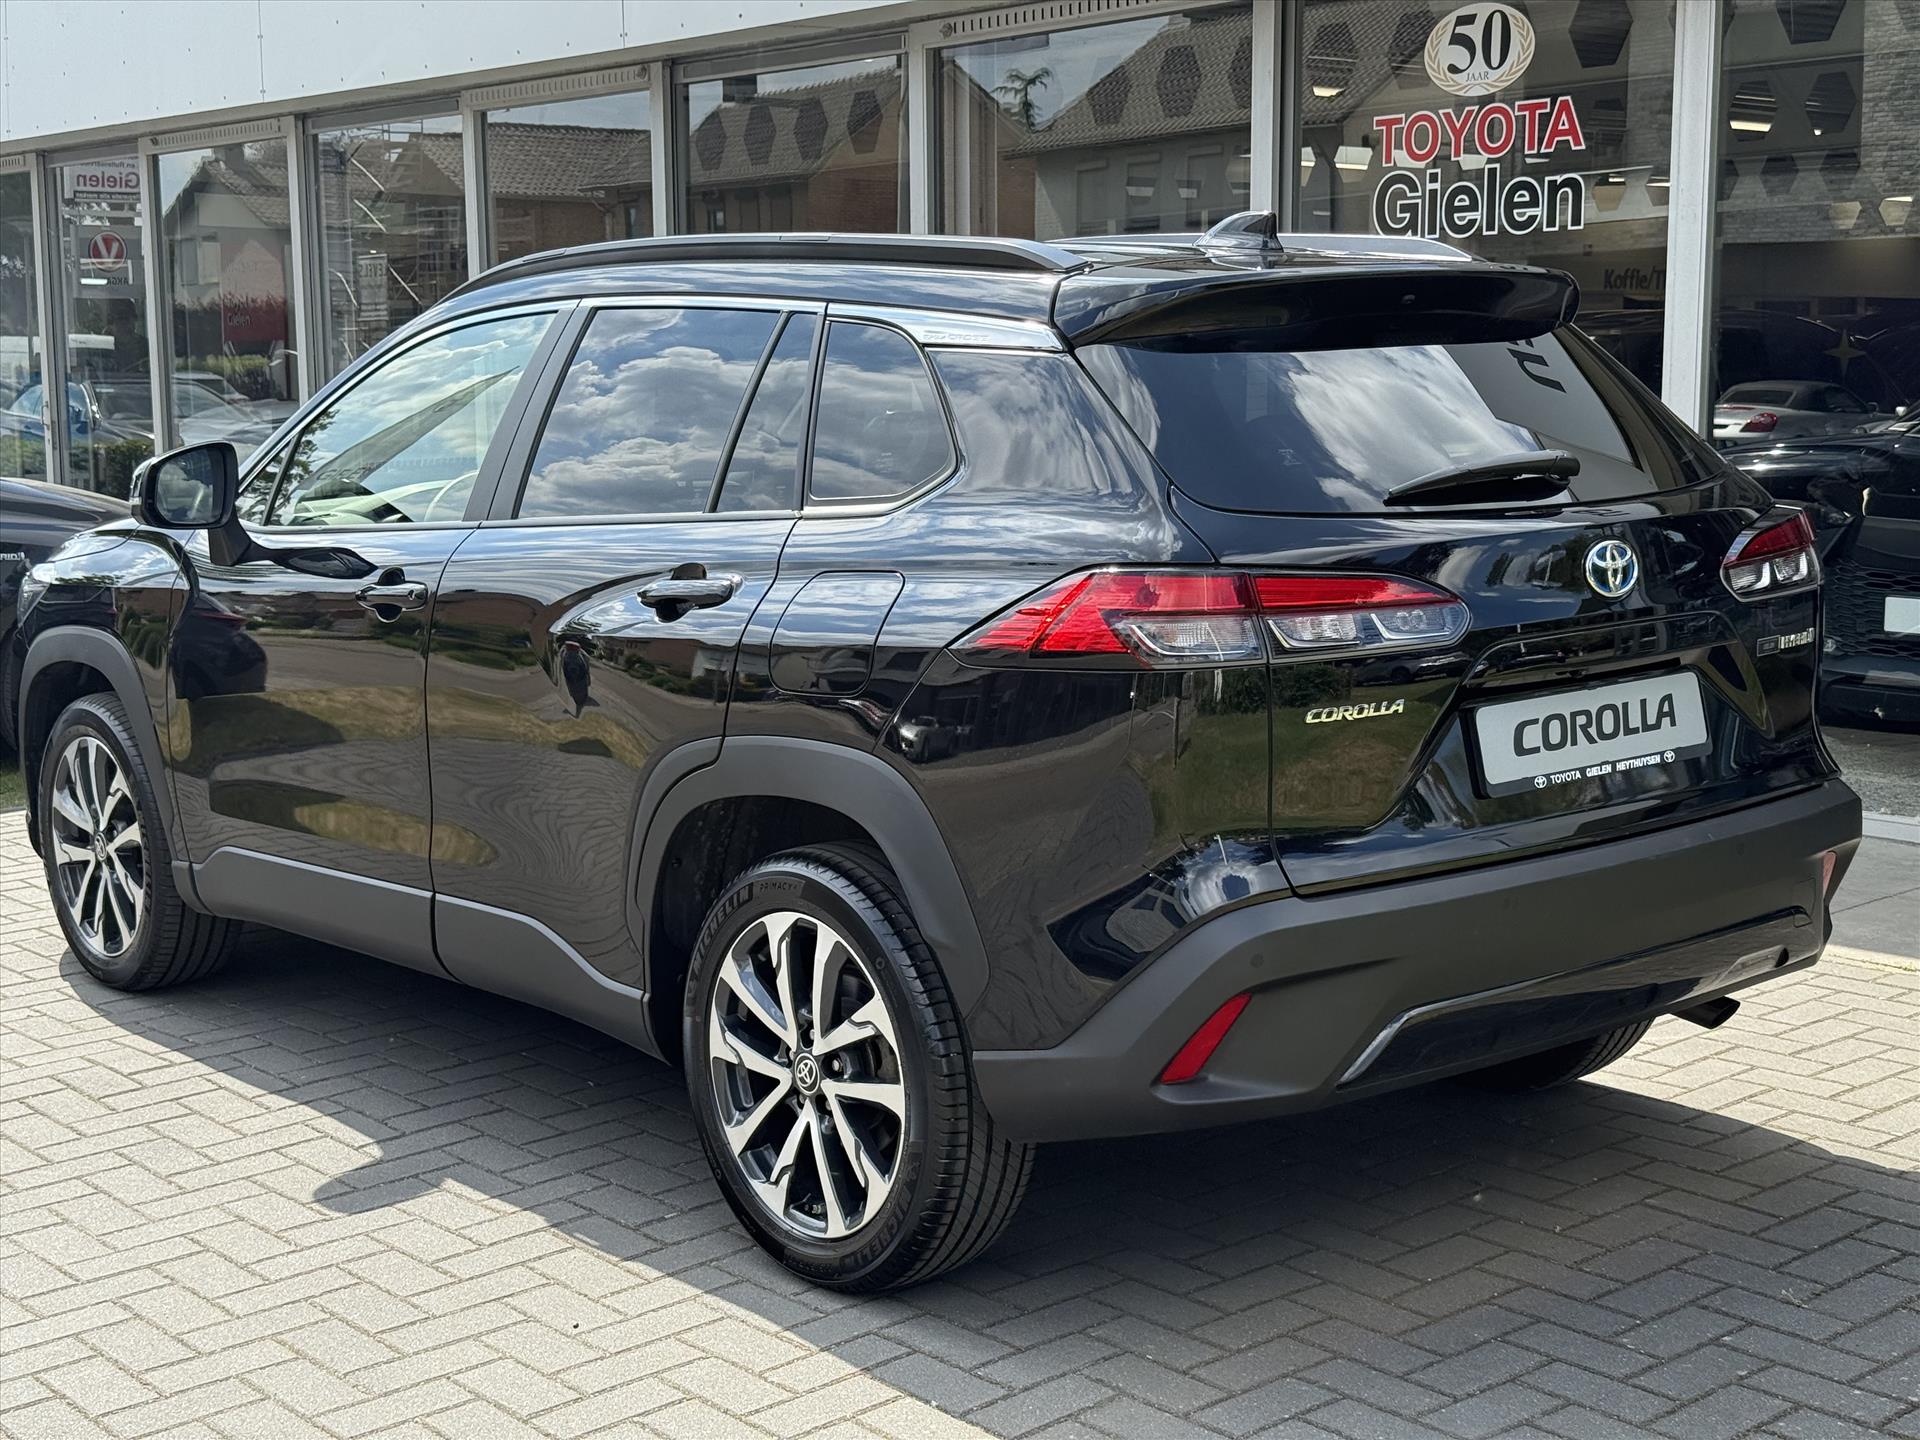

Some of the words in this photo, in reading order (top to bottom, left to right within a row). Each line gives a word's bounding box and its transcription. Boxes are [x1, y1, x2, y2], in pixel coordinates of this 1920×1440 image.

[1447, 9, 1511, 75] 50
[1465, 71, 1490, 82] JAAR
[1373, 96, 1586, 167] TOYOTA
[1373, 163, 1586, 239] Gielen
[1306, 699, 1405, 723] COROLLA
[1513, 693, 1676, 757] COROLLA
[1550, 771, 1581, 784] TOYOTA
[1586, 764, 1612, 777] GIELEN
[1616, 754, 1661, 771] HEYTHUYSEN
